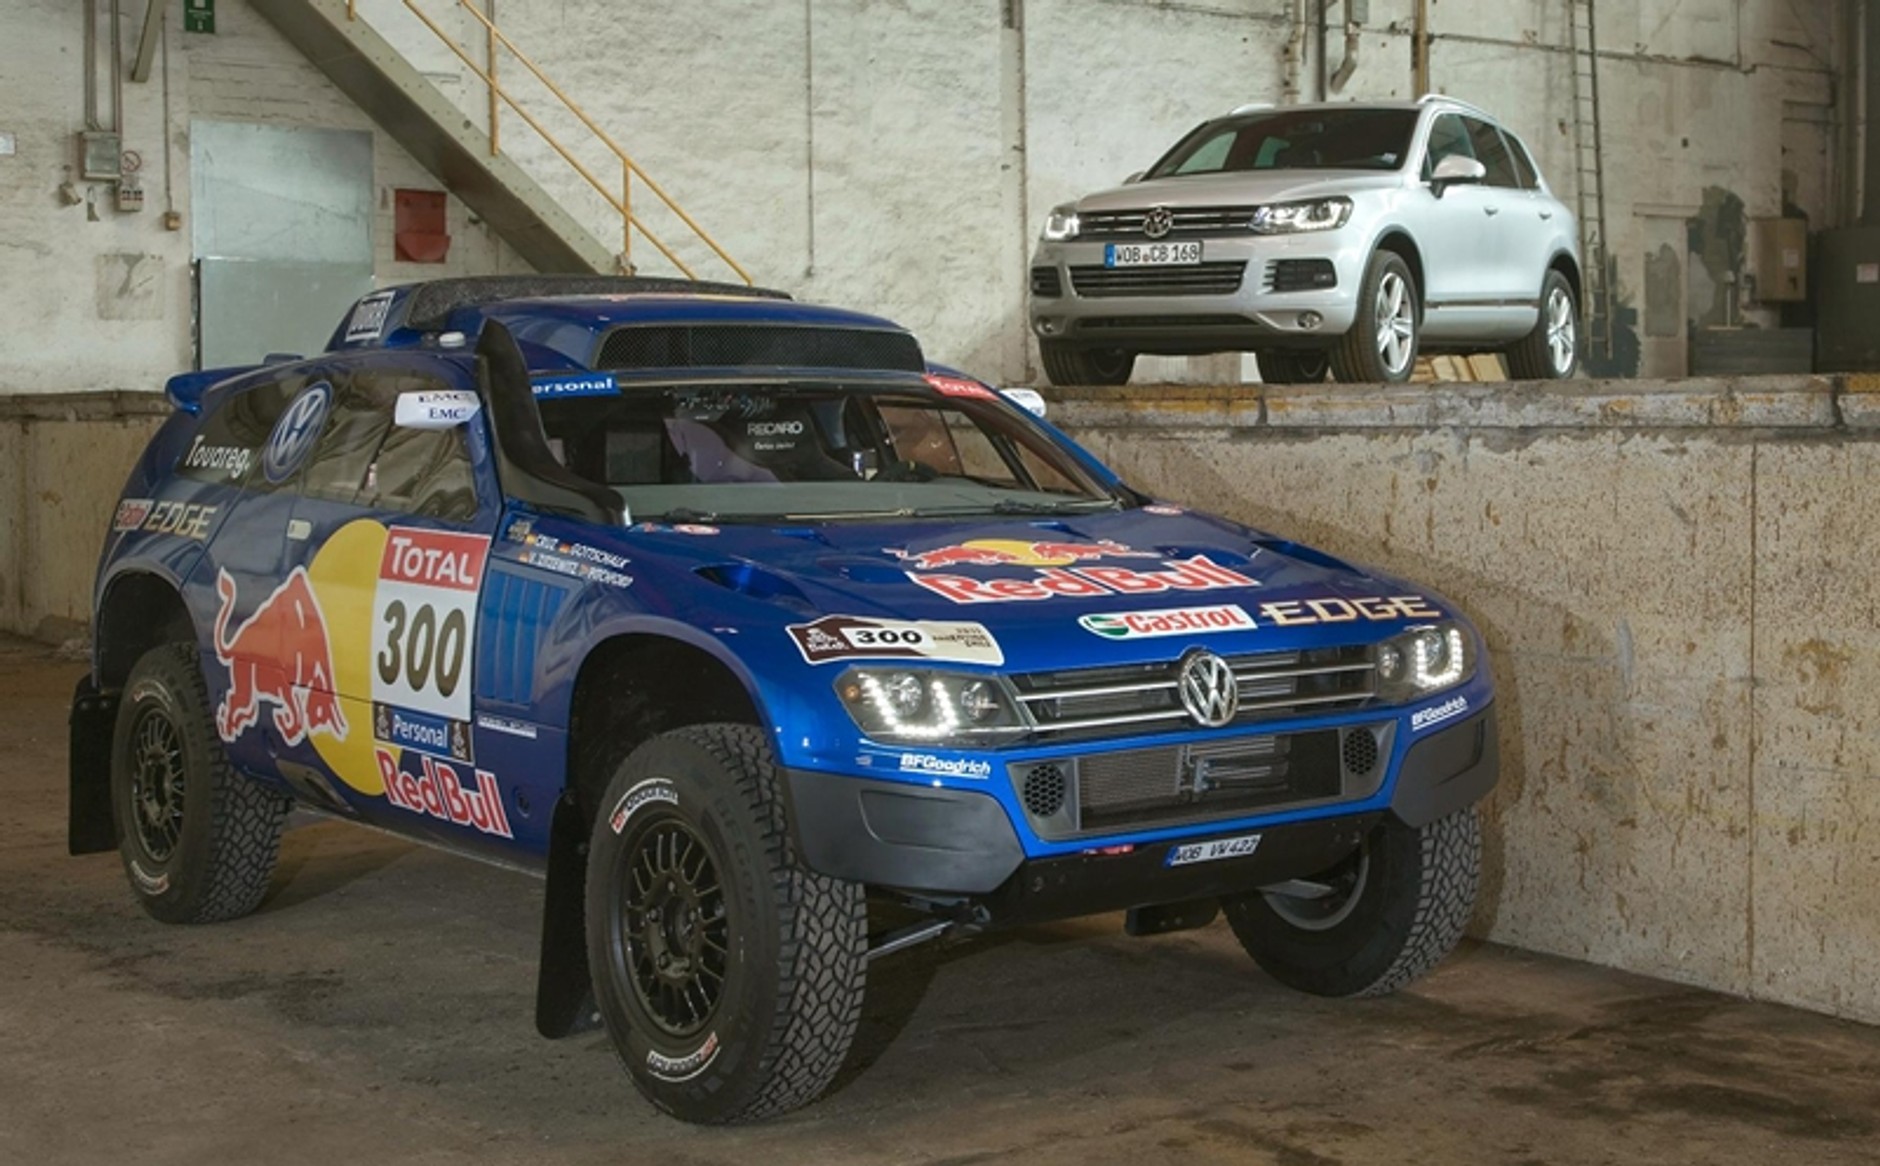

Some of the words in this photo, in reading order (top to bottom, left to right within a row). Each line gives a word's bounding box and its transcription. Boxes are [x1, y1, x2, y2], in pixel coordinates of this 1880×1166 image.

[1172, 244, 1198, 261] 168
[531, 378, 613, 394] ersonal
[747, 421, 803, 436] RECARO
[144, 501, 218, 539] EDGE
[391, 536, 473, 585] TOTAL
[903, 567, 1116, 605] Red
[1070, 554, 1263, 597] Bull
[1123, 607, 1248, 635] Castrol
[1261, 596, 1441, 626] EDGE
[378, 599, 467, 698] 300
[855, 630, 923, 645] 300
[393, 714, 448, 749] Personal
[900, 753, 991, 777] BFGoodrich
[375, 746, 449, 821] Red
[435, 760, 514, 840] Bull
